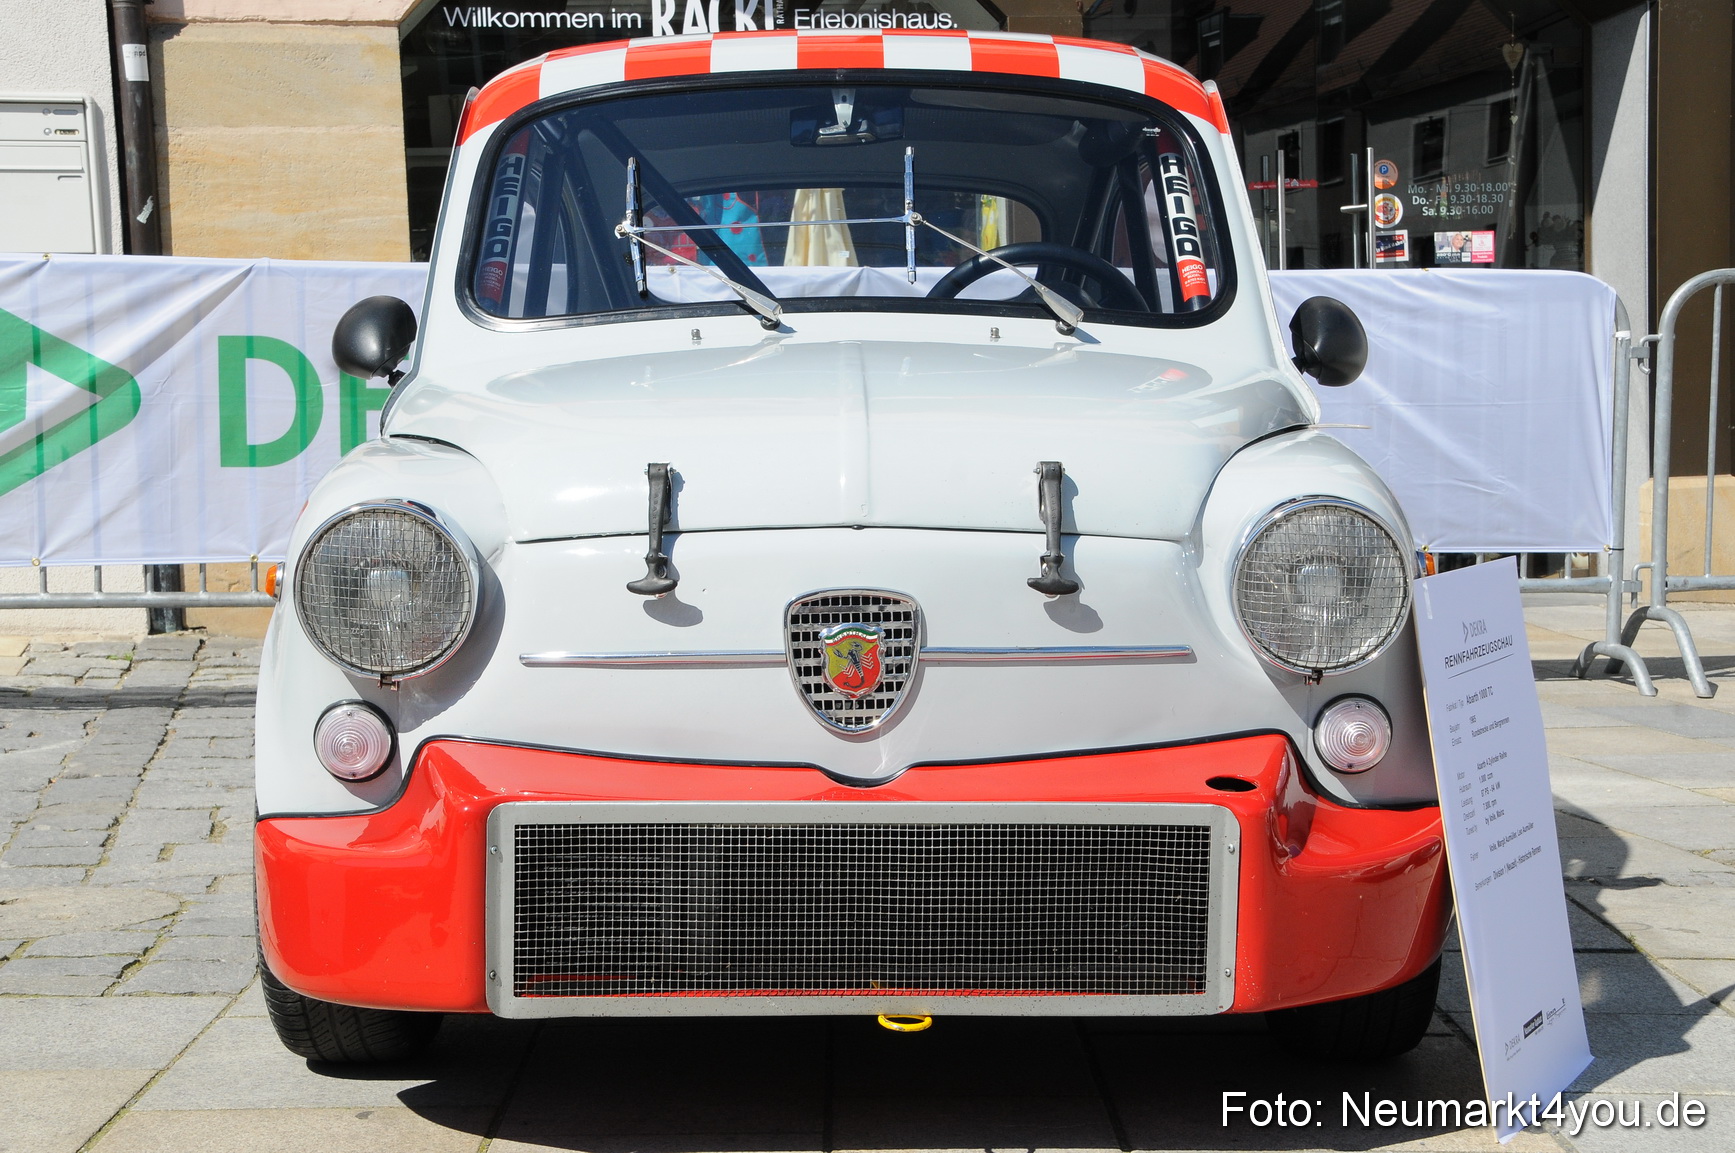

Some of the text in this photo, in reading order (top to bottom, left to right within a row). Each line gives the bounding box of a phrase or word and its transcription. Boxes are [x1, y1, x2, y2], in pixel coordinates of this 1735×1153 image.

[443, 7, 642, 28] Willkommen im
[794, 8, 958, 29] Erlebnishaus.
[1408, 184, 1427, 194] Mo.
[1455, 182, 1508, 192] 9.30-18.00
[484, 156, 523, 260] HEIGO
[1162, 154, 1202, 259] HEIGO
[1450, 194, 1504, 204] 9.30-18.30
[1422, 205, 1494, 216] Sa. 9.30-16.00
[1469, 619, 1487, 637] DEKRA
[1444, 635, 1513, 669] RENNFAHRZEUGSCHAU
[1466, 691, 1478, 704] Abarth
[1487, 685, 1493, 696] TC
